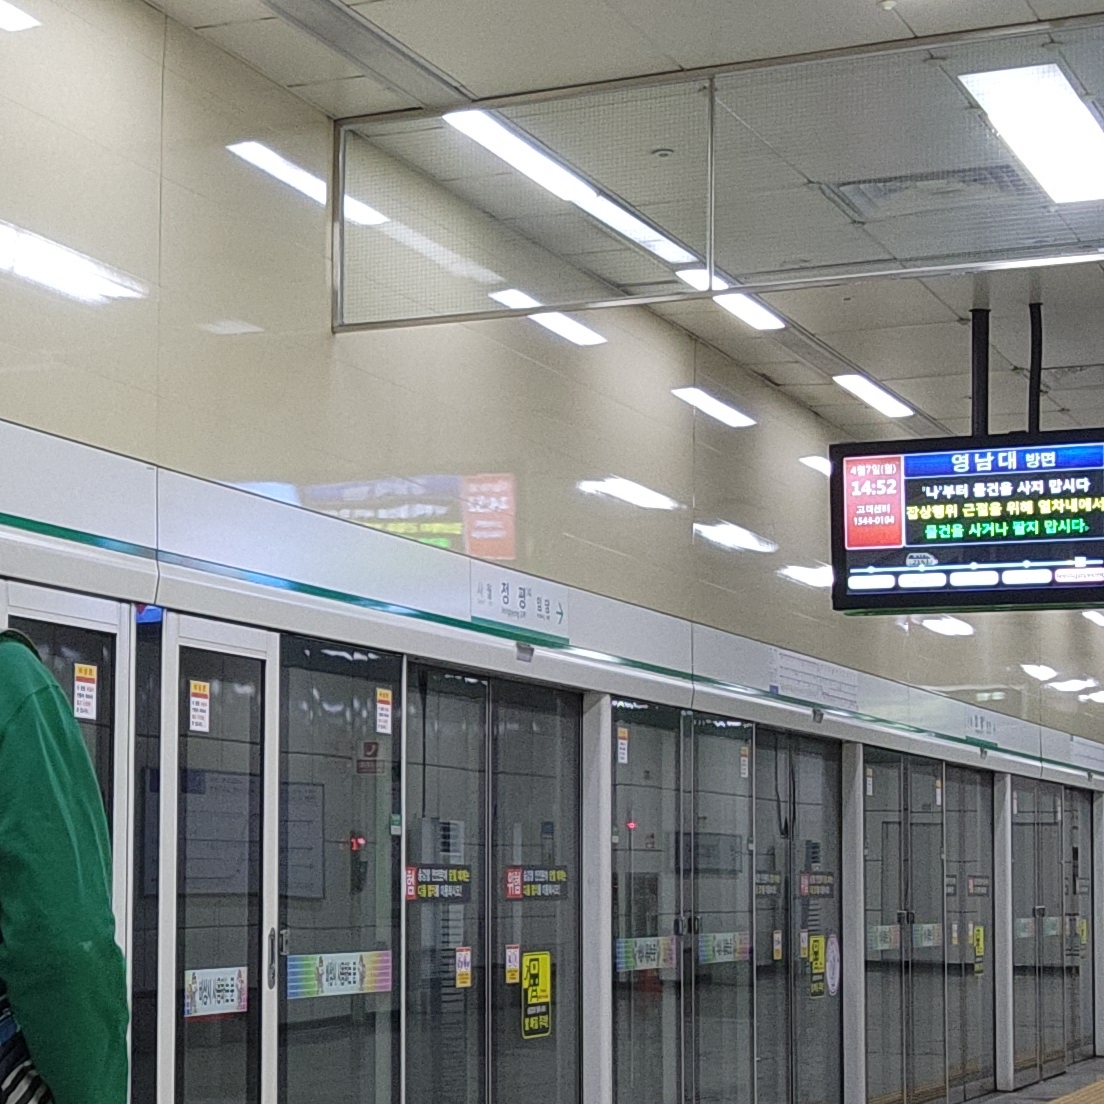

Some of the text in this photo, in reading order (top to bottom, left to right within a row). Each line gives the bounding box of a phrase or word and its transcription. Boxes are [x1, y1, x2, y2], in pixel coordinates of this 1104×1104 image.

[951, 451, 1056, 473] 영남대 방면
[851, 479, 897, 497] 14:52
[973, 481, 1014, 498] 물건을
[1017, 479, 1044, 496] 사지
[1006, 499, 1034, 516] 위해
[924, 523, 965, 540] 물건을
[968, 521, 1009, 537] 사거나
[1013, 519, 1039, 536] 팔지
[501, 582, 527, 610] 정평
